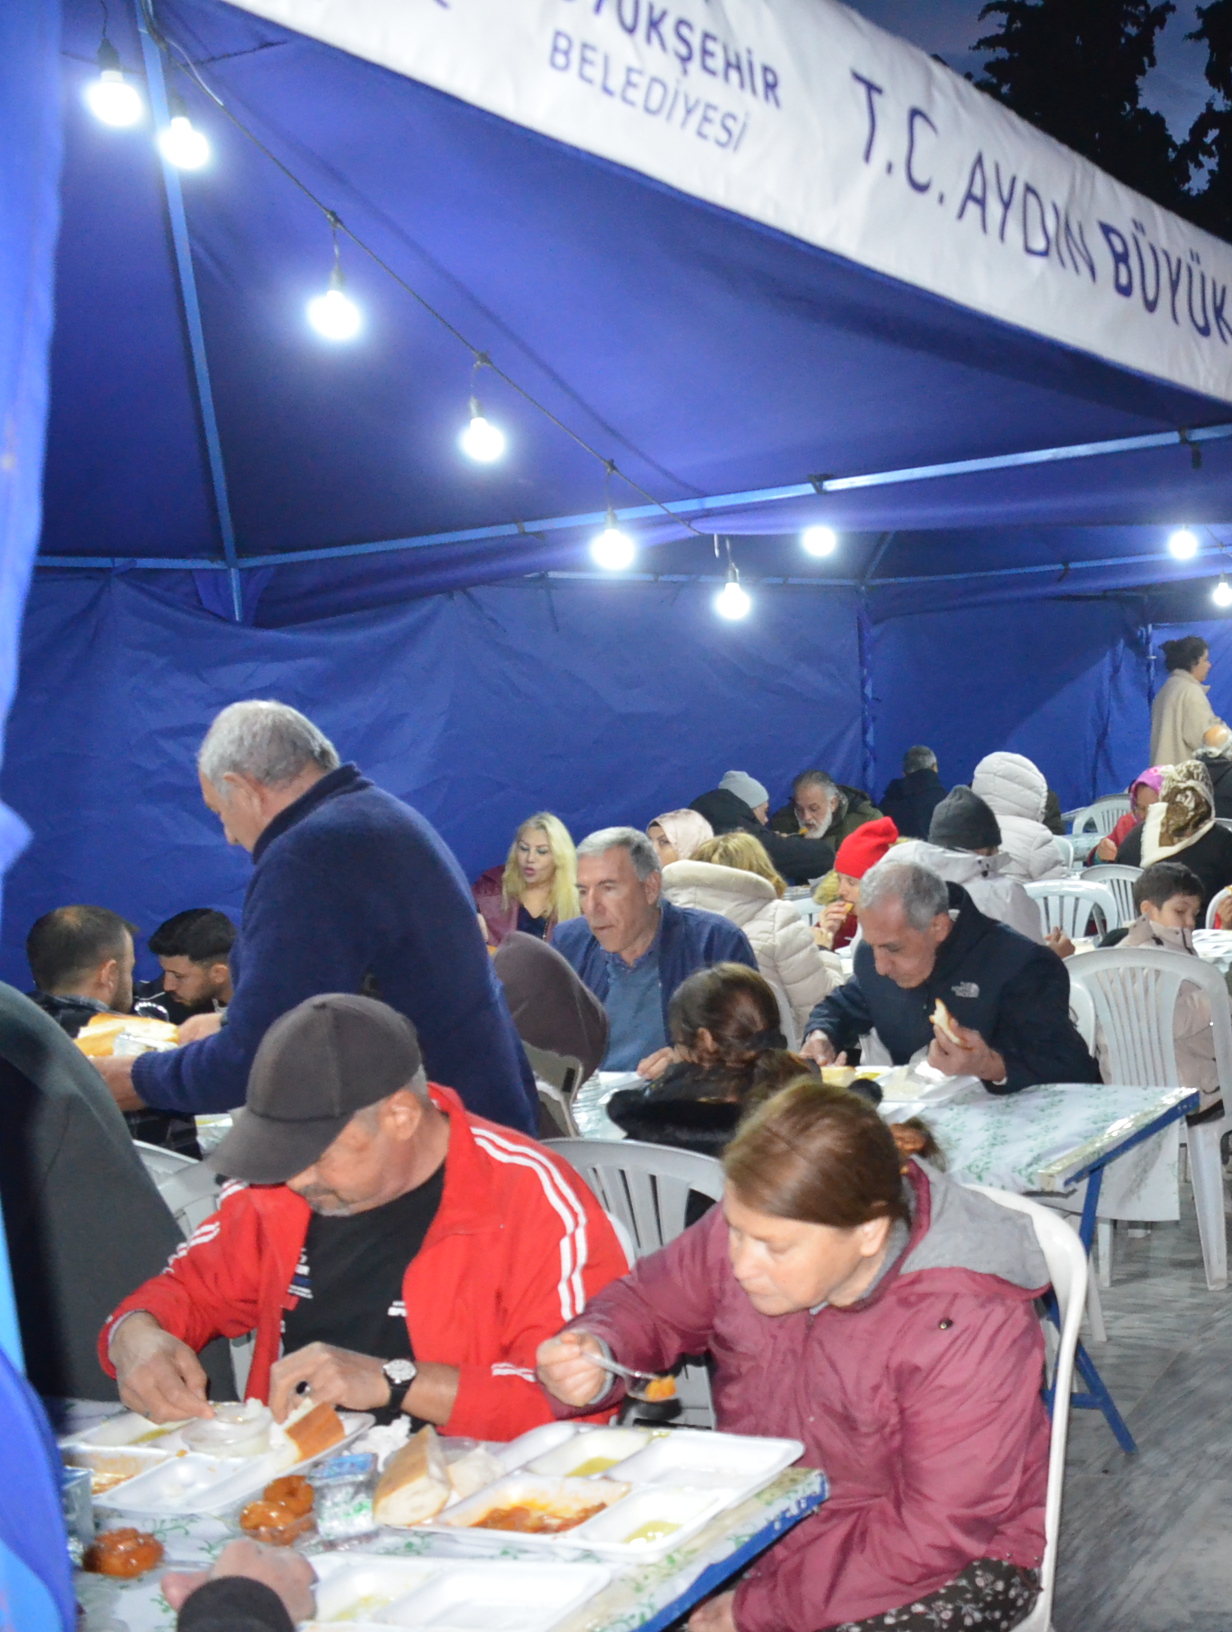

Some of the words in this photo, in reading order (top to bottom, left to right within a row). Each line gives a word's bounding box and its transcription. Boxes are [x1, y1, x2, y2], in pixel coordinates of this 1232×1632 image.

[550, 29, 748, 154] BELEDİYESİ
[851, 70, 945, 204] T.C.
[957, 149, 1096, 283] AYDIN
